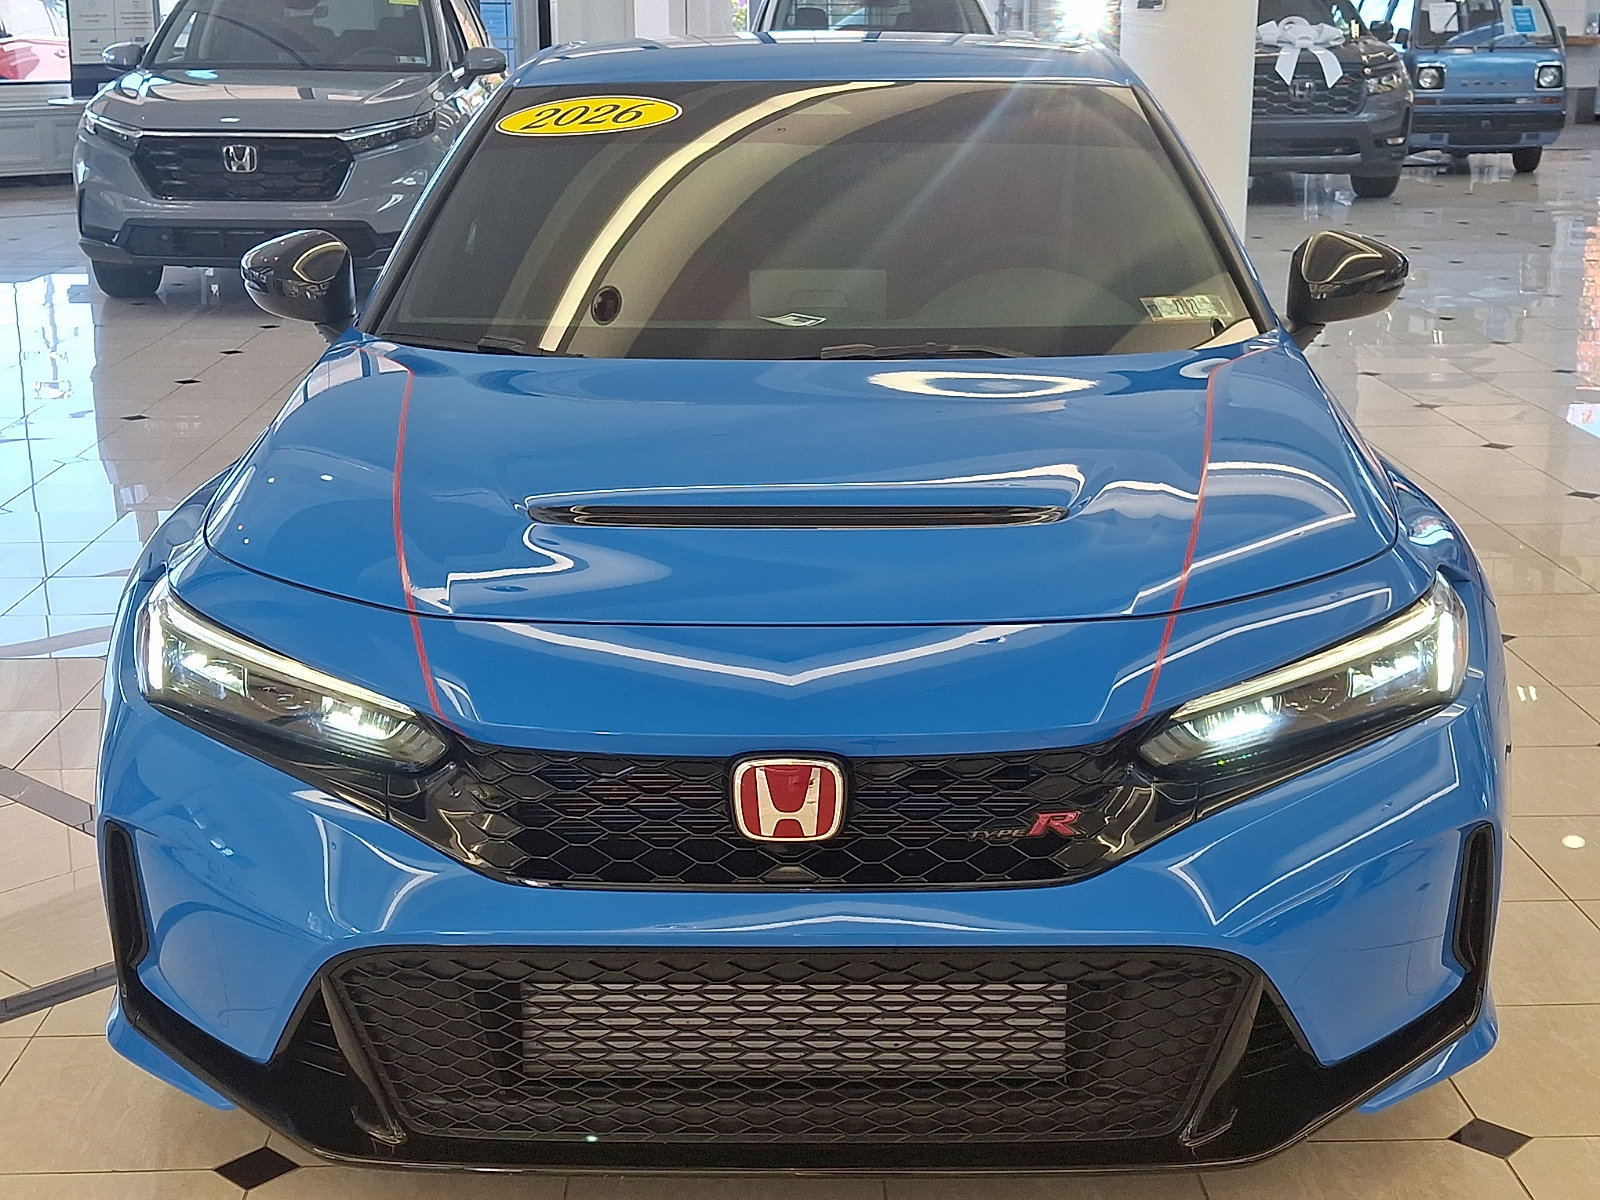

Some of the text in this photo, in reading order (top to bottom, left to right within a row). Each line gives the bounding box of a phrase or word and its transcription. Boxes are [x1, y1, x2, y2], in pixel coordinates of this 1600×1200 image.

[520, 103, 655, 130] 2026
[968, 811, 1082, 841] TYPE R
